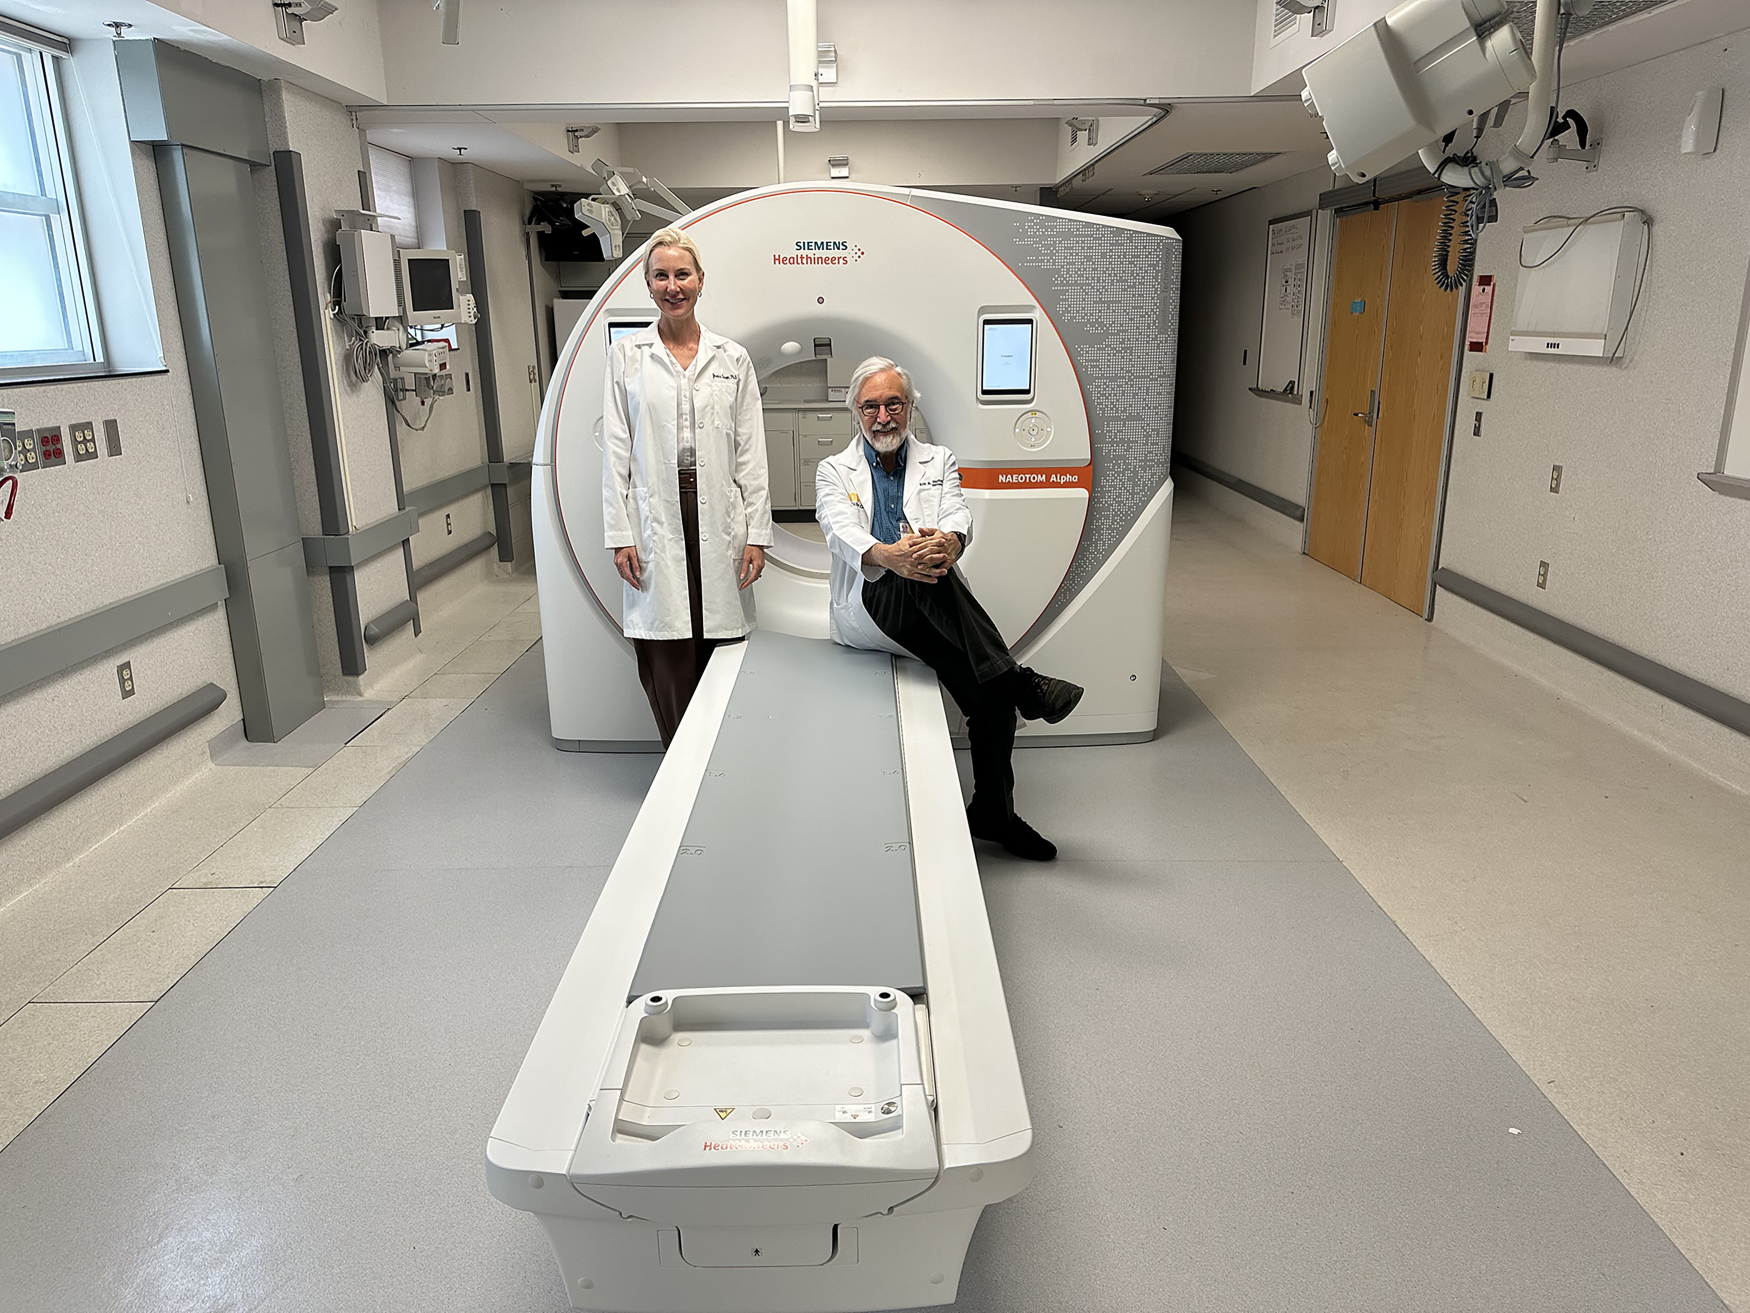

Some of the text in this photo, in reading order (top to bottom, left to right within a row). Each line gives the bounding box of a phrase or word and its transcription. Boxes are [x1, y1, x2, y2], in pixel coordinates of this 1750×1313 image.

[795, 241, 848, 251] SIEMENS
[773, 253, 848, 265] Healthineers
[1162, 247, 1170, 293] Technology
[998, 473, 1078, 484] NAEOTOM Alpha
[680, 848, 704, 856] 2.0
[731, 1129, 789, 1138] SIEMENS
[703, 1141, 789, 1151] Healtneers
